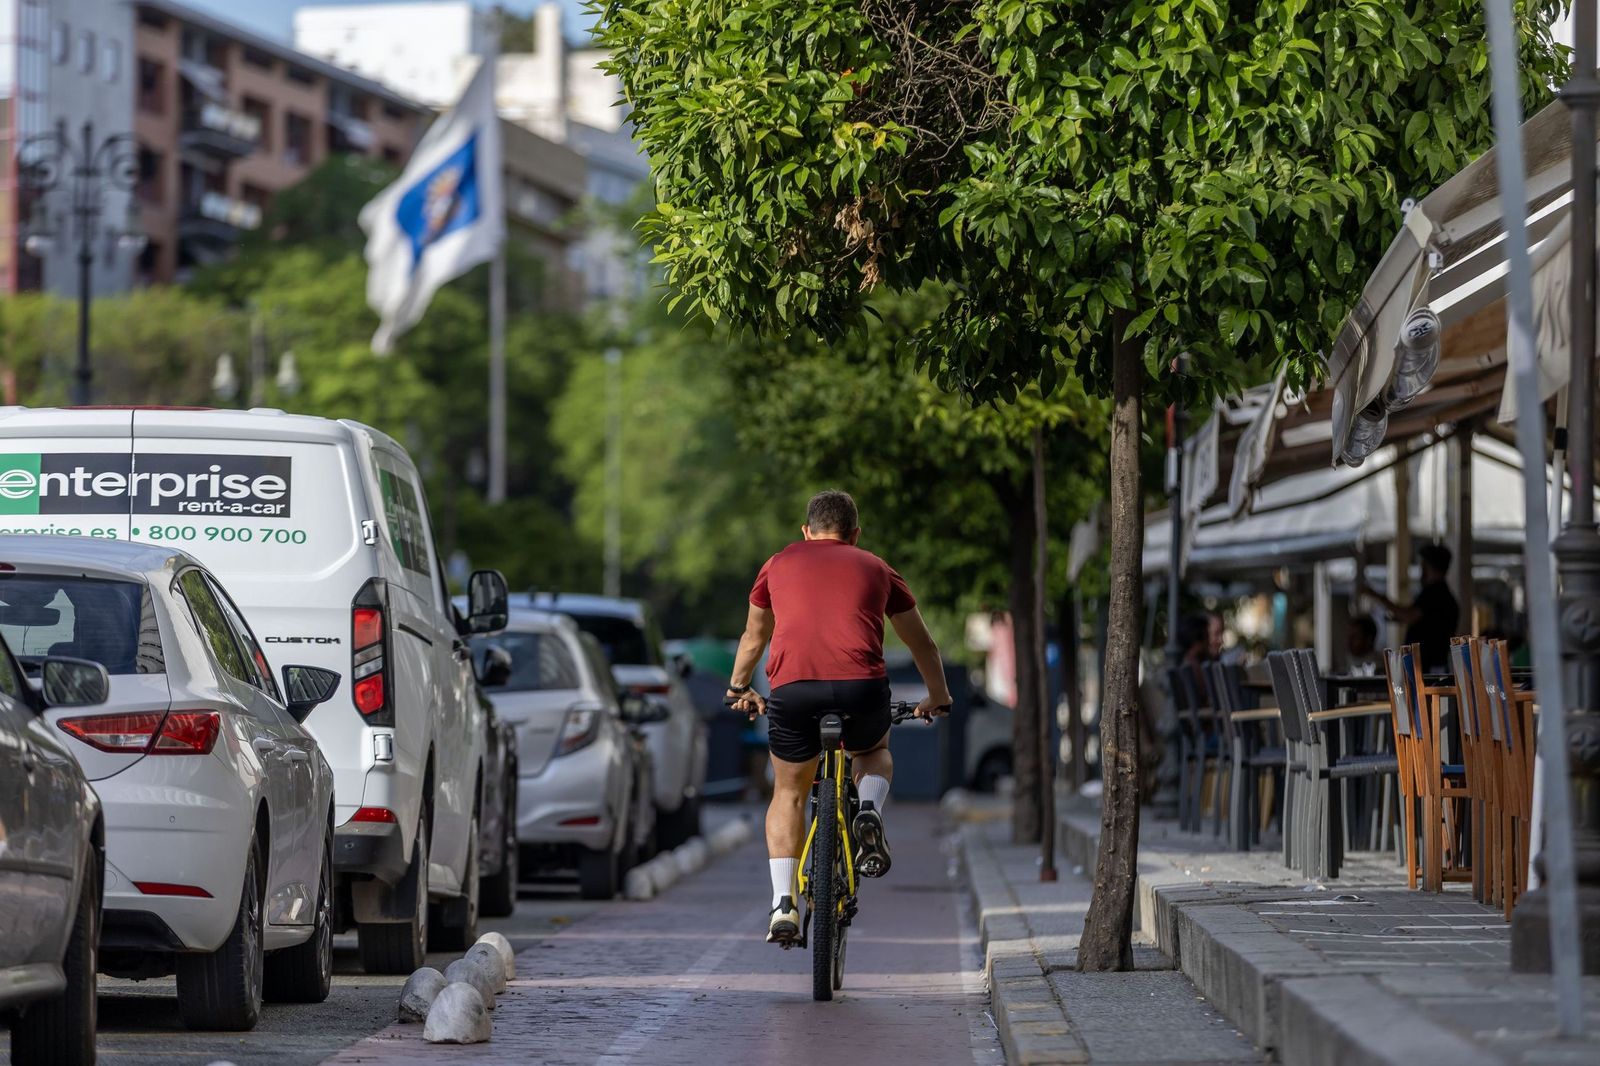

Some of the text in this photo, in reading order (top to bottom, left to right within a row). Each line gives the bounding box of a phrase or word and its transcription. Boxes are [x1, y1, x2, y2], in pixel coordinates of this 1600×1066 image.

[0, 464, 287, 507] enterprise
[178, 500, 286, 515] rent-a-car
[149, 525, 197, 541] 800
[204, 527, 253, 543] 900
[259, 528, 307, 545] 700
[265, 636, 341, 645] CUSTOM
